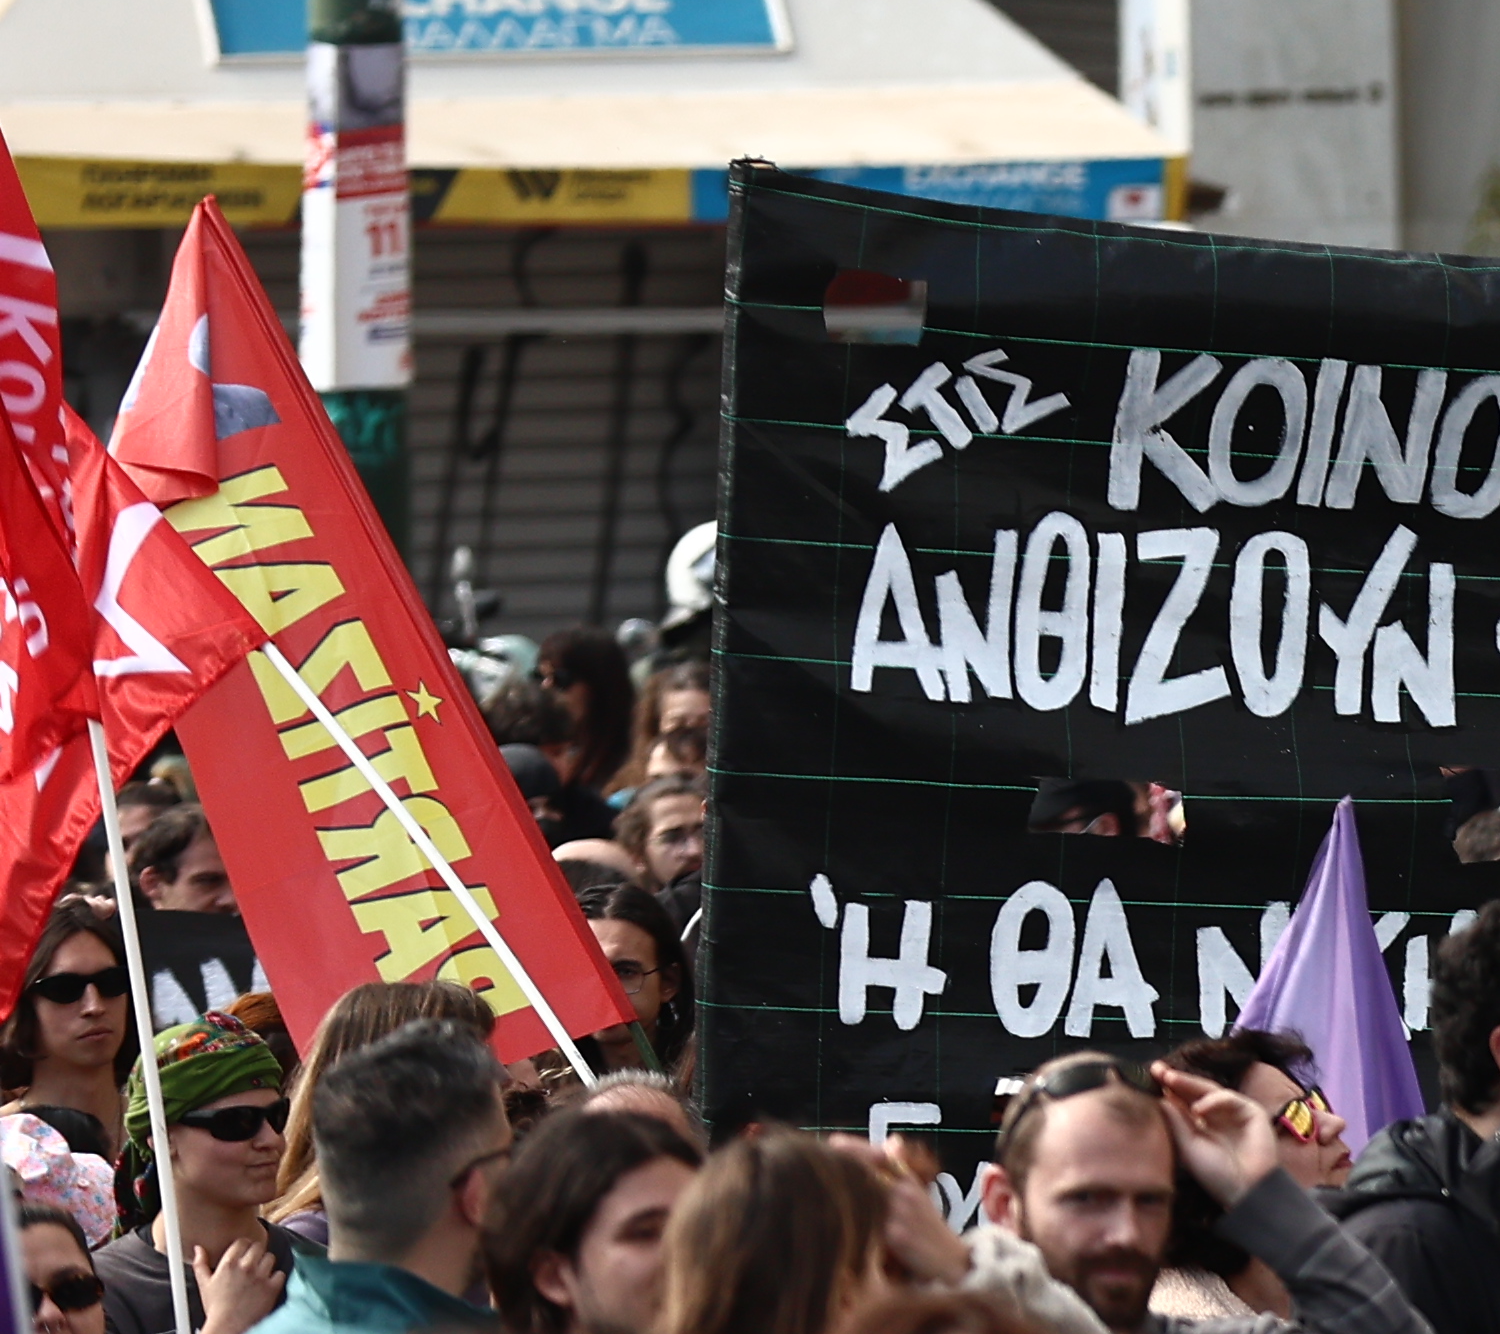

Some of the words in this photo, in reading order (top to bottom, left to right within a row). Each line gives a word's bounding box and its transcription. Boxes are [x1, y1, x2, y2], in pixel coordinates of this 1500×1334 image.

[845, 348, 1071, 492] ΣΤΙΣ
[850, 511, 1457, 727] ΑΝΘΙΖΟΥΝ
[990, 877, 1159, 1040] ΘΑ
